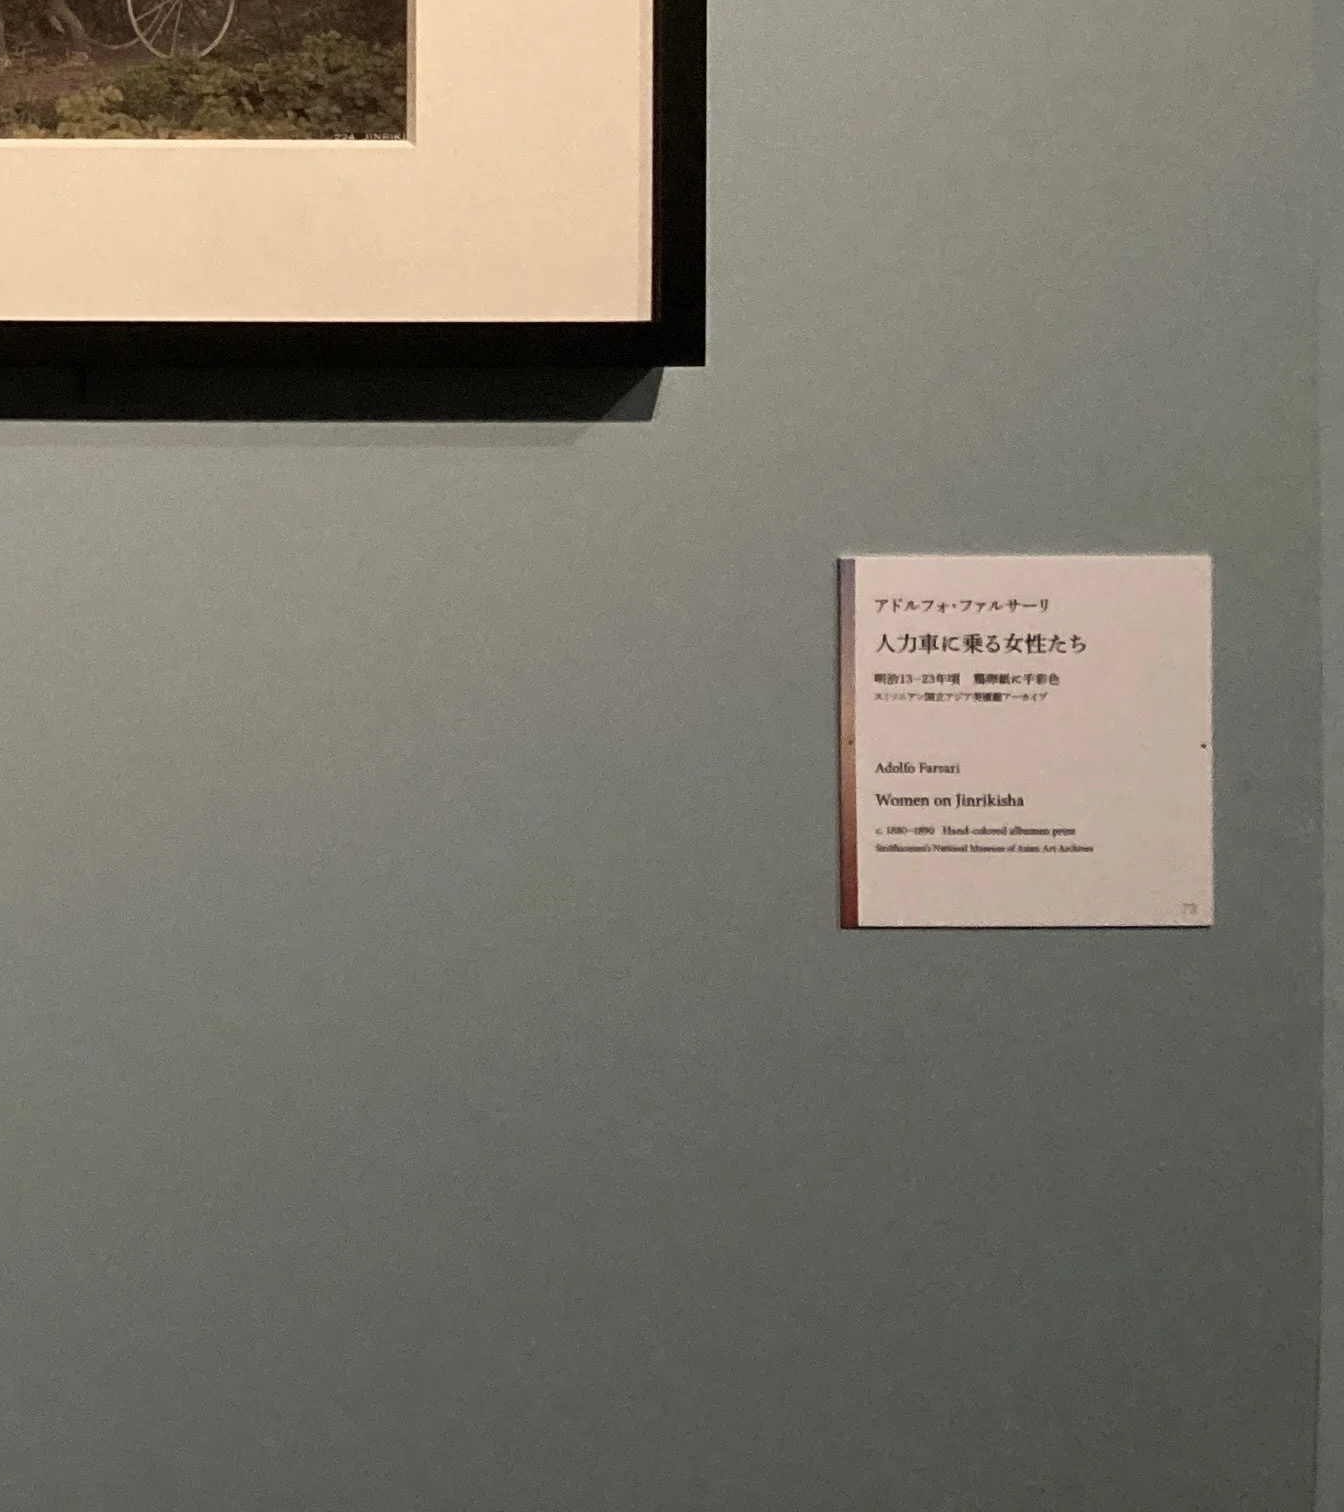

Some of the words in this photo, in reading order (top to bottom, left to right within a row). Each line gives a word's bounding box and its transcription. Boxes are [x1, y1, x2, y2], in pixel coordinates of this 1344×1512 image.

[876, 632, 1087, 655] 人力車に乗る女性たち
[874, 761, 917, 774] Adolfo
[918, 761, 961, 774] Farsari
[874, 793, 930, 807] Women
[933, 796, 952, 808] on
[955, 792, 1025, 809] Jinrikisha
